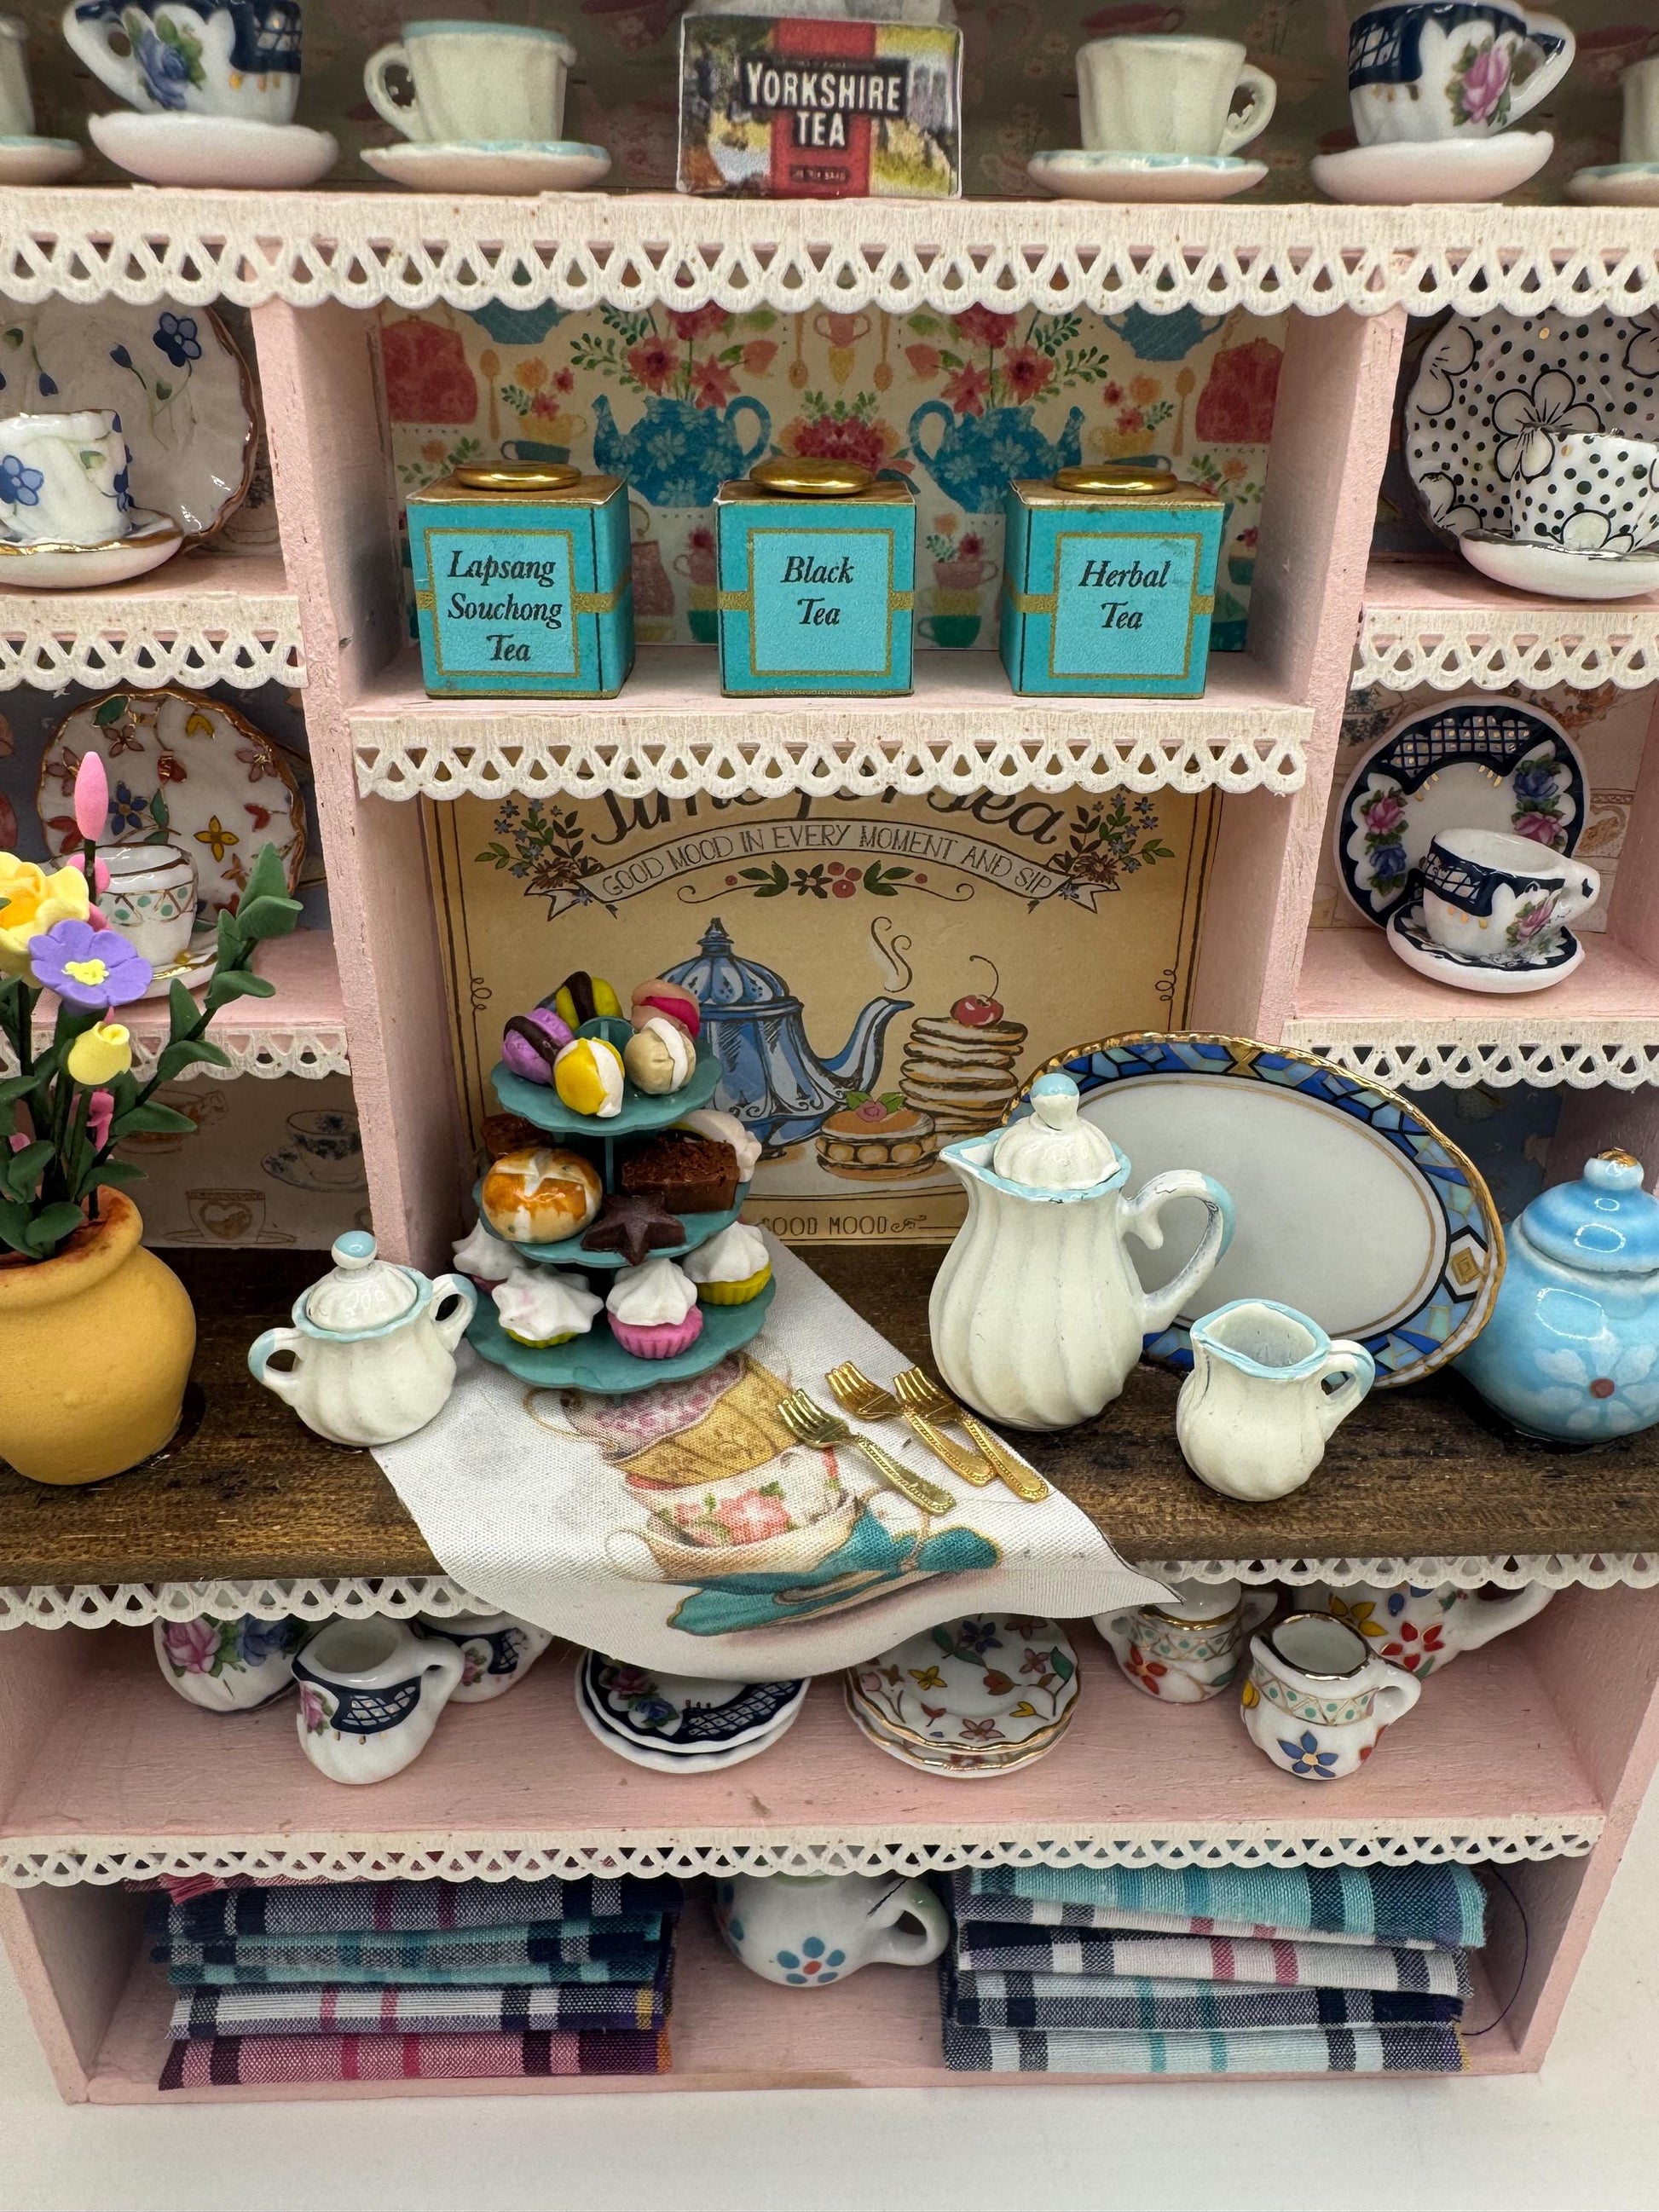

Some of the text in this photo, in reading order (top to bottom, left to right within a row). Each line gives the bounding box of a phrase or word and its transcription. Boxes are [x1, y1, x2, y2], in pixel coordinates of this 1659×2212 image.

[746, 61, 903, 112] YORKSHIRE
[796, 111, 847, 147] TEA
[447, 550, 557, 588] Lapsang
[779, 555, 855, 584] Black
[1078, 559, 1171, 588] Herbal
[447, 592, 563, 630] Souchong
[796, 598, 841, 626] Tea
[1100, 601, 1144, 630] Tea
[485, 633, 532, 662] Tea
[602, 823, 1052, 896] GOOD MOOD IN EVERY MOMENT AND SIP
[829, 1216, 887, 1236] MOOD
